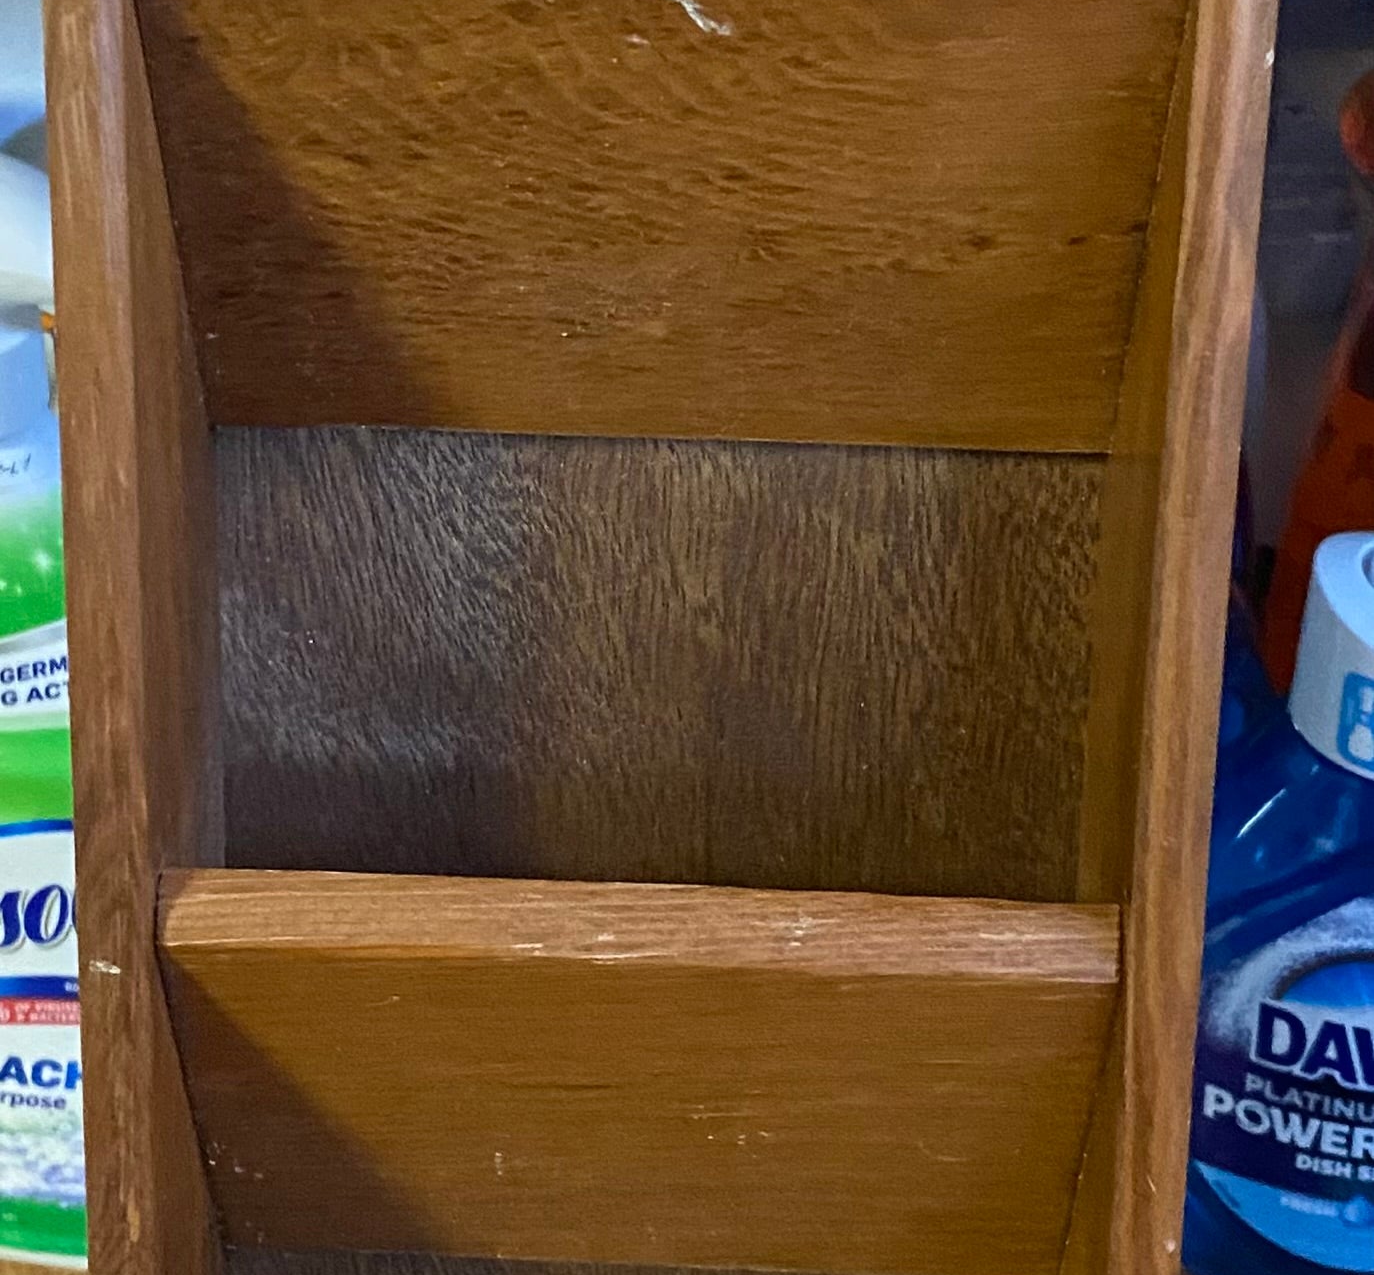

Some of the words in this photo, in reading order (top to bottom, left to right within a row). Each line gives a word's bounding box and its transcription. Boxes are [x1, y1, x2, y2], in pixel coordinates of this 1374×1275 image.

[0, 656, 68, 684] GERM
[27, 681, 69, 703] AC
[1203, 1084, 1374, 1159] POWER
